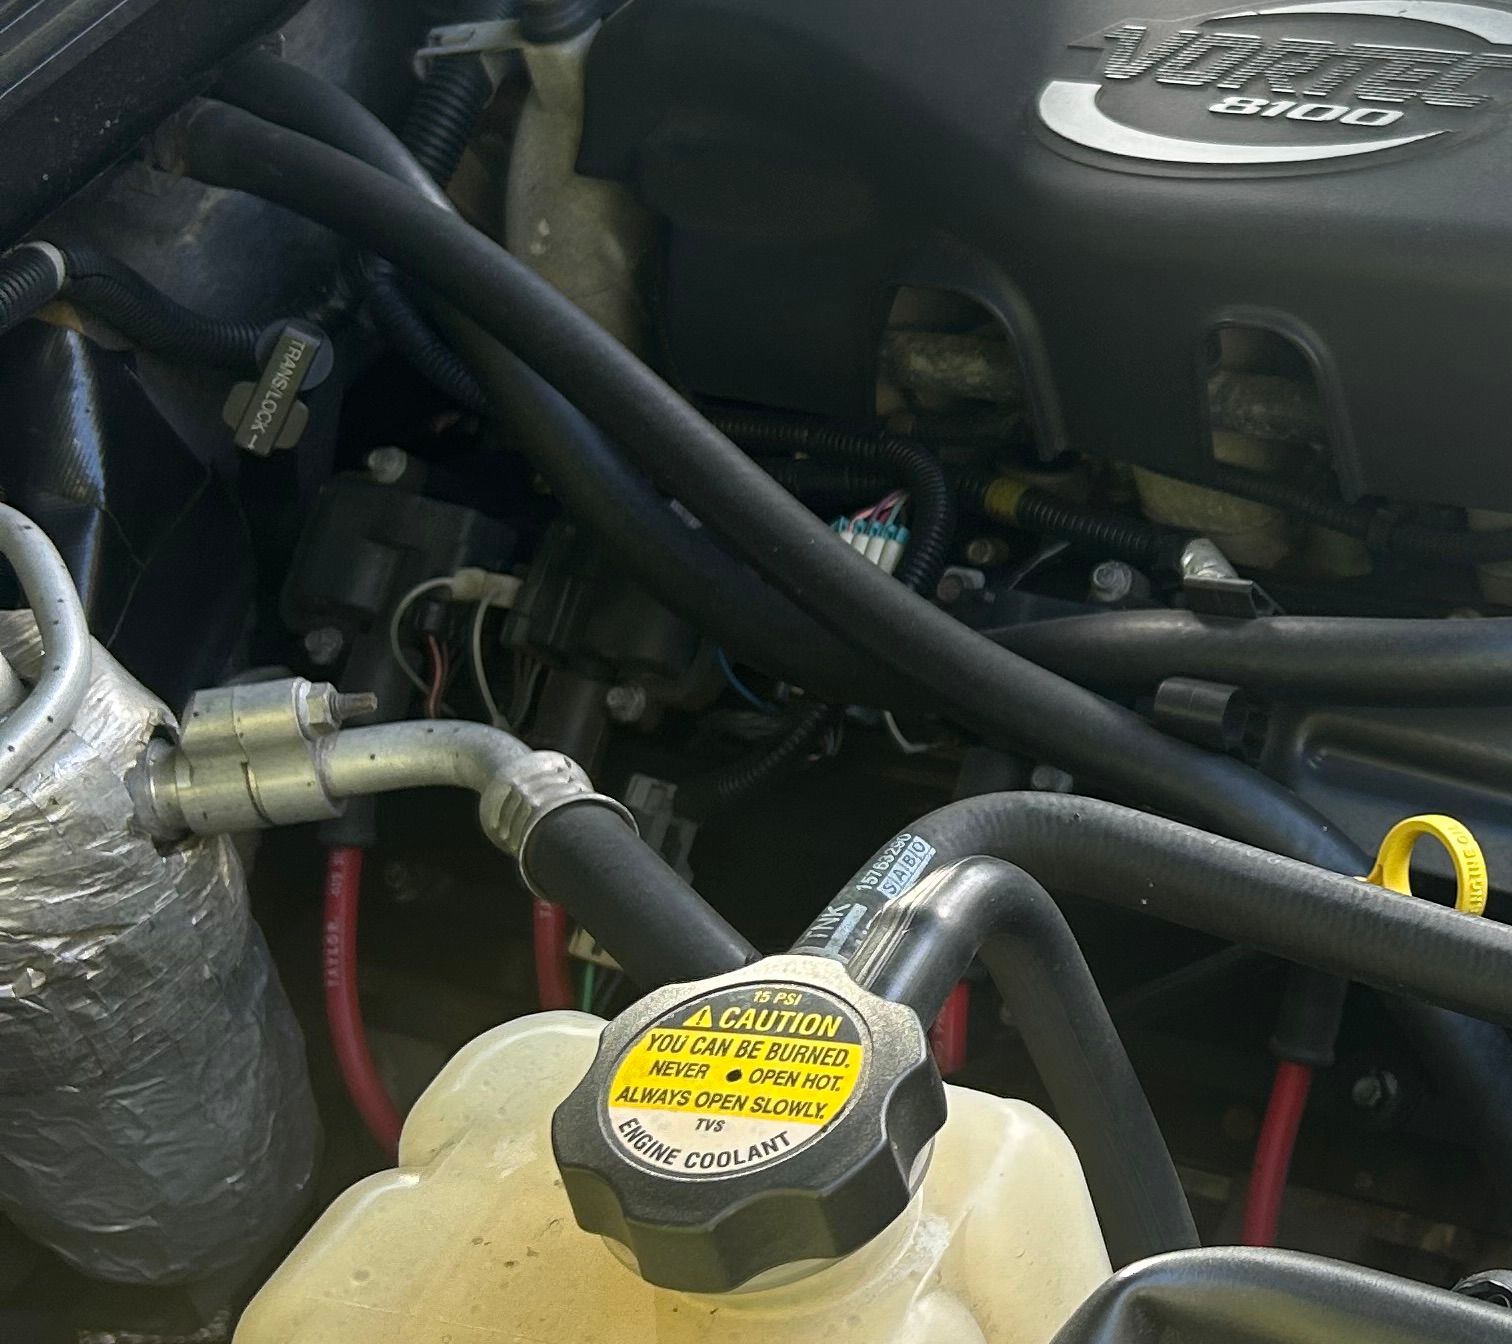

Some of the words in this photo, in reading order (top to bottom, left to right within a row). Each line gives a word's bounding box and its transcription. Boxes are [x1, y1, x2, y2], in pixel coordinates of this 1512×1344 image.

[1208, 96, 1404, 126] 8100
[753, 990, 767, 1003] 15
[773, 991, 803, 1006] PSI
[719, 1007, 843, 1038] CAUTION
[647, 1034, 687, 1054] YOU
[691, 1037, 734, 1056] CAN
[735, 1040, 763, 1059] BE
[765, 1042, 851, 1068] BURNED.
[648, 1060, 710, 1079] NEVER
[749, 1068, 804, 1087] OPEN
[802, 1073, 844, 1092] HOT.
[615, 1086, 691, 1107] ALWAYS
[694, 1091, 748, 1112] OPEN
[750, 1096, 829, 1120] SLOWLY.
[696, 1118, 726, 1133] TVS
[618, 1117, 682, 1166] ENGINE
[684, 1131, 793, 1169] COOLANT
